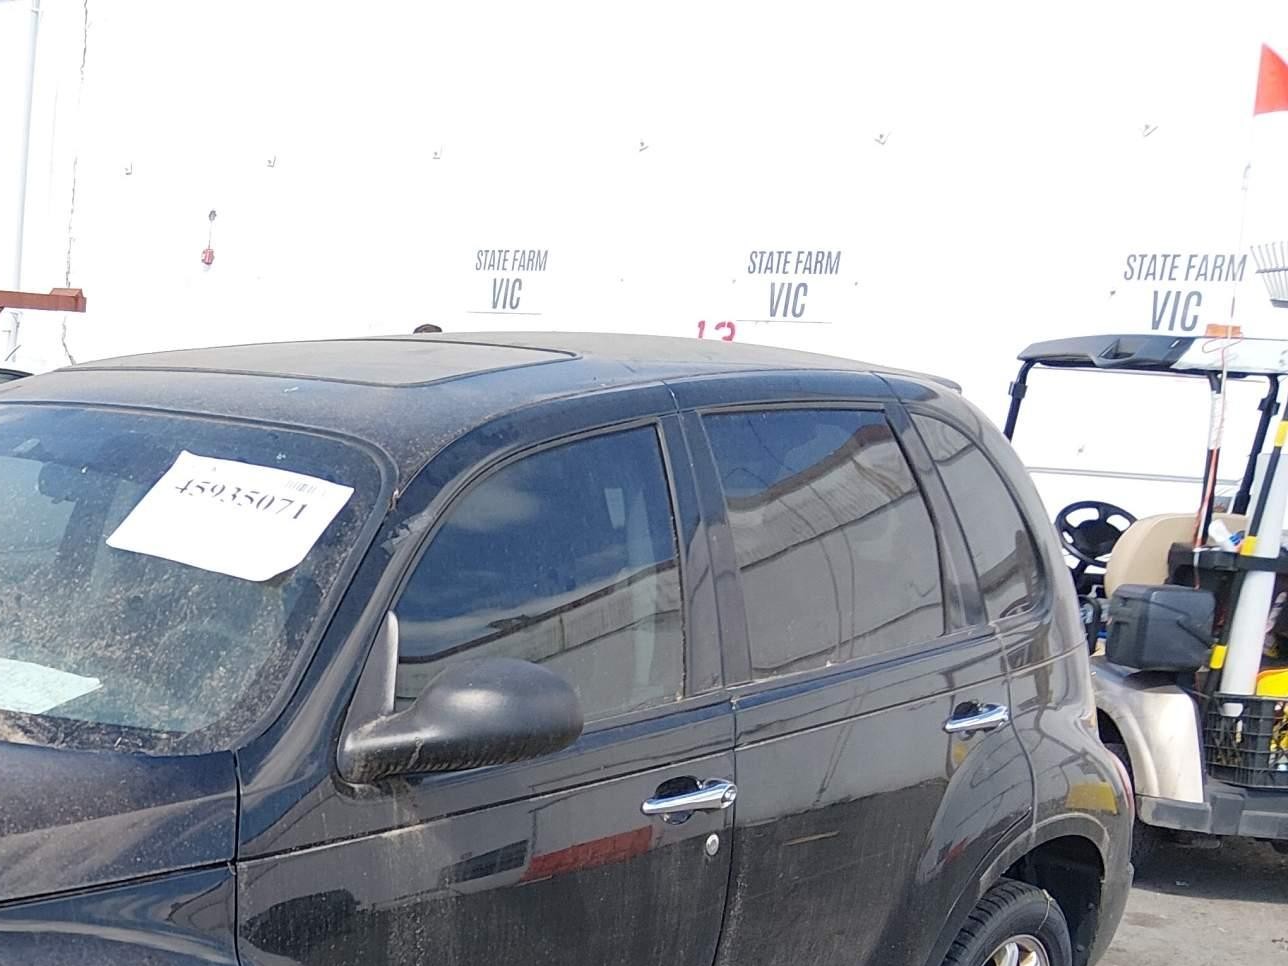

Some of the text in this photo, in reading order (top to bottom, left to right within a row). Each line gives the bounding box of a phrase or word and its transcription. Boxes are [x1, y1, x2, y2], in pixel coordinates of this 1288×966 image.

[475, 249, 549, 272] STATE FARM
[747, 250, 842, 275] STATE FARM
[1123, 253, 1248, 282] STATE FARM
[491, 277, 523, 310] VIC
[769, 281, 808, 318] VIC
[1151, 290, 1203, 332] VIC
[175, 479, 308, 520] 45935071
